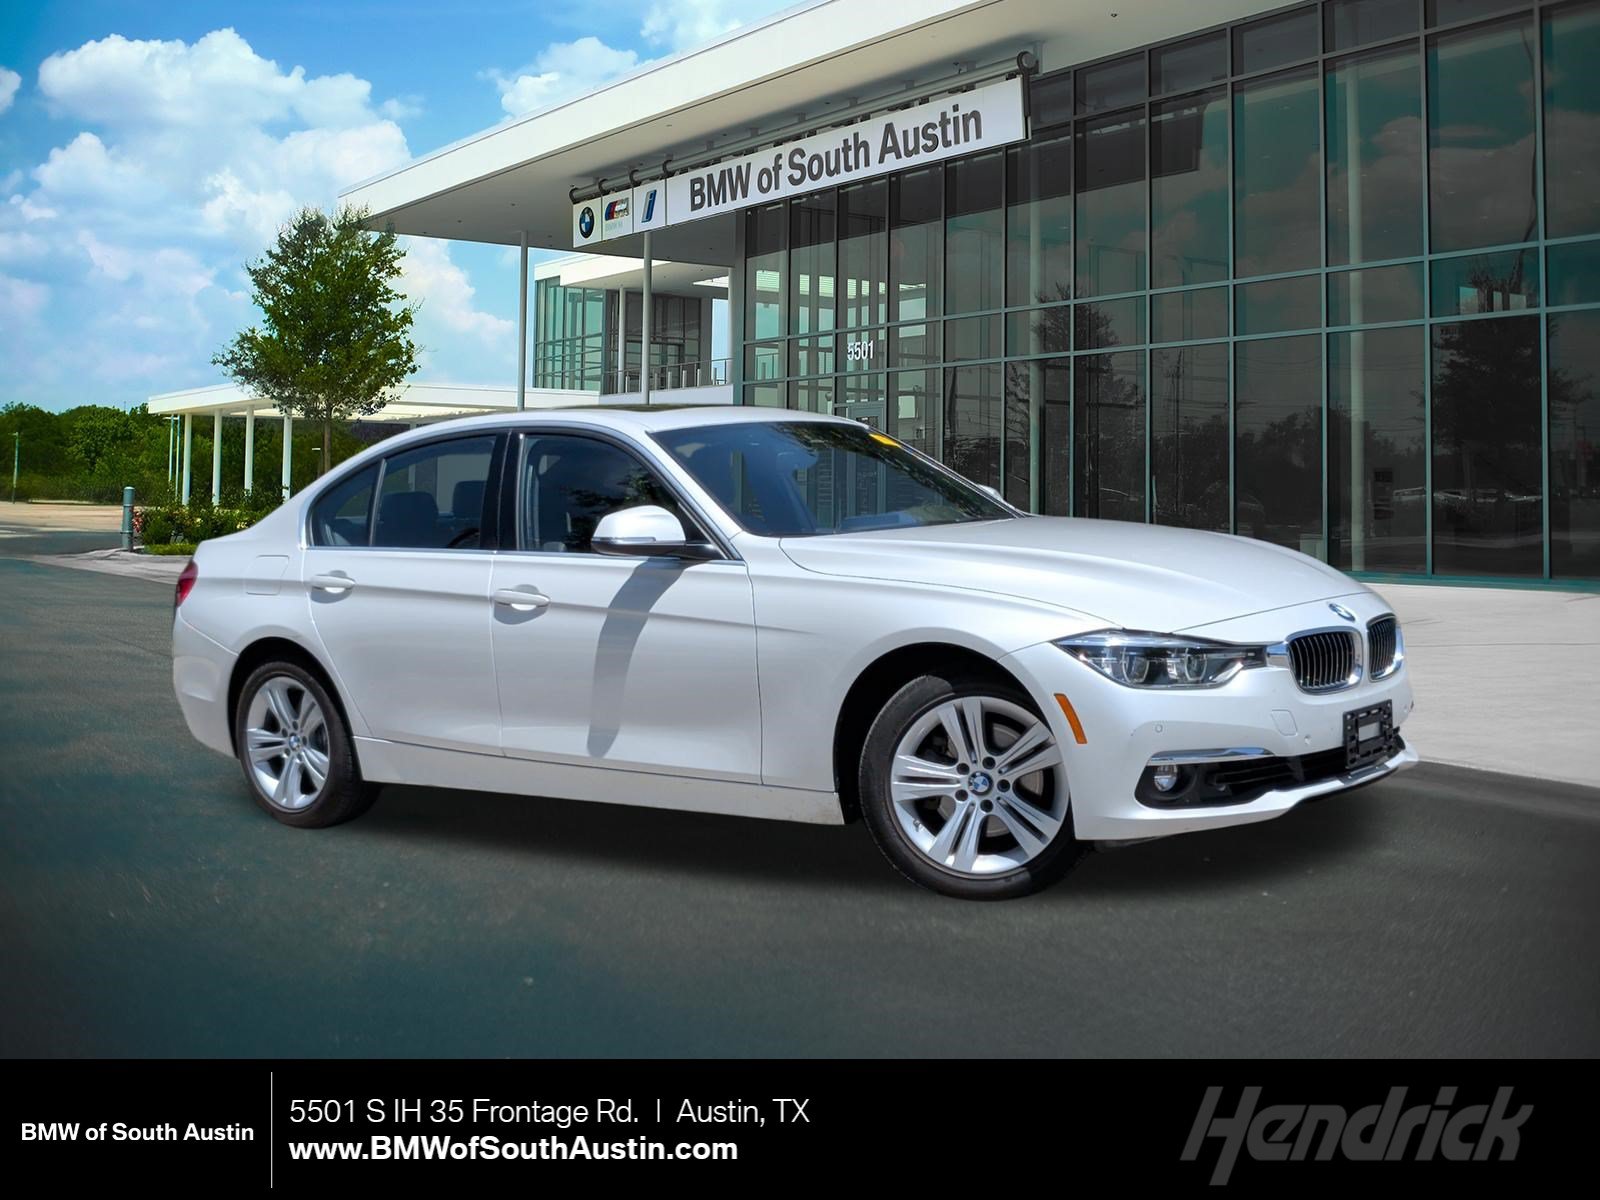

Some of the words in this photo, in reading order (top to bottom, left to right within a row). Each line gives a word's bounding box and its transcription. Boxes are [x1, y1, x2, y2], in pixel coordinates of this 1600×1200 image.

[690, 162, 752, 212] BMW
[757, 153, 783, 194] of
[787, 131, 871, 187] South
[878, 103, 983, 164] Austin
[847, 340, 874, 361] 5501
